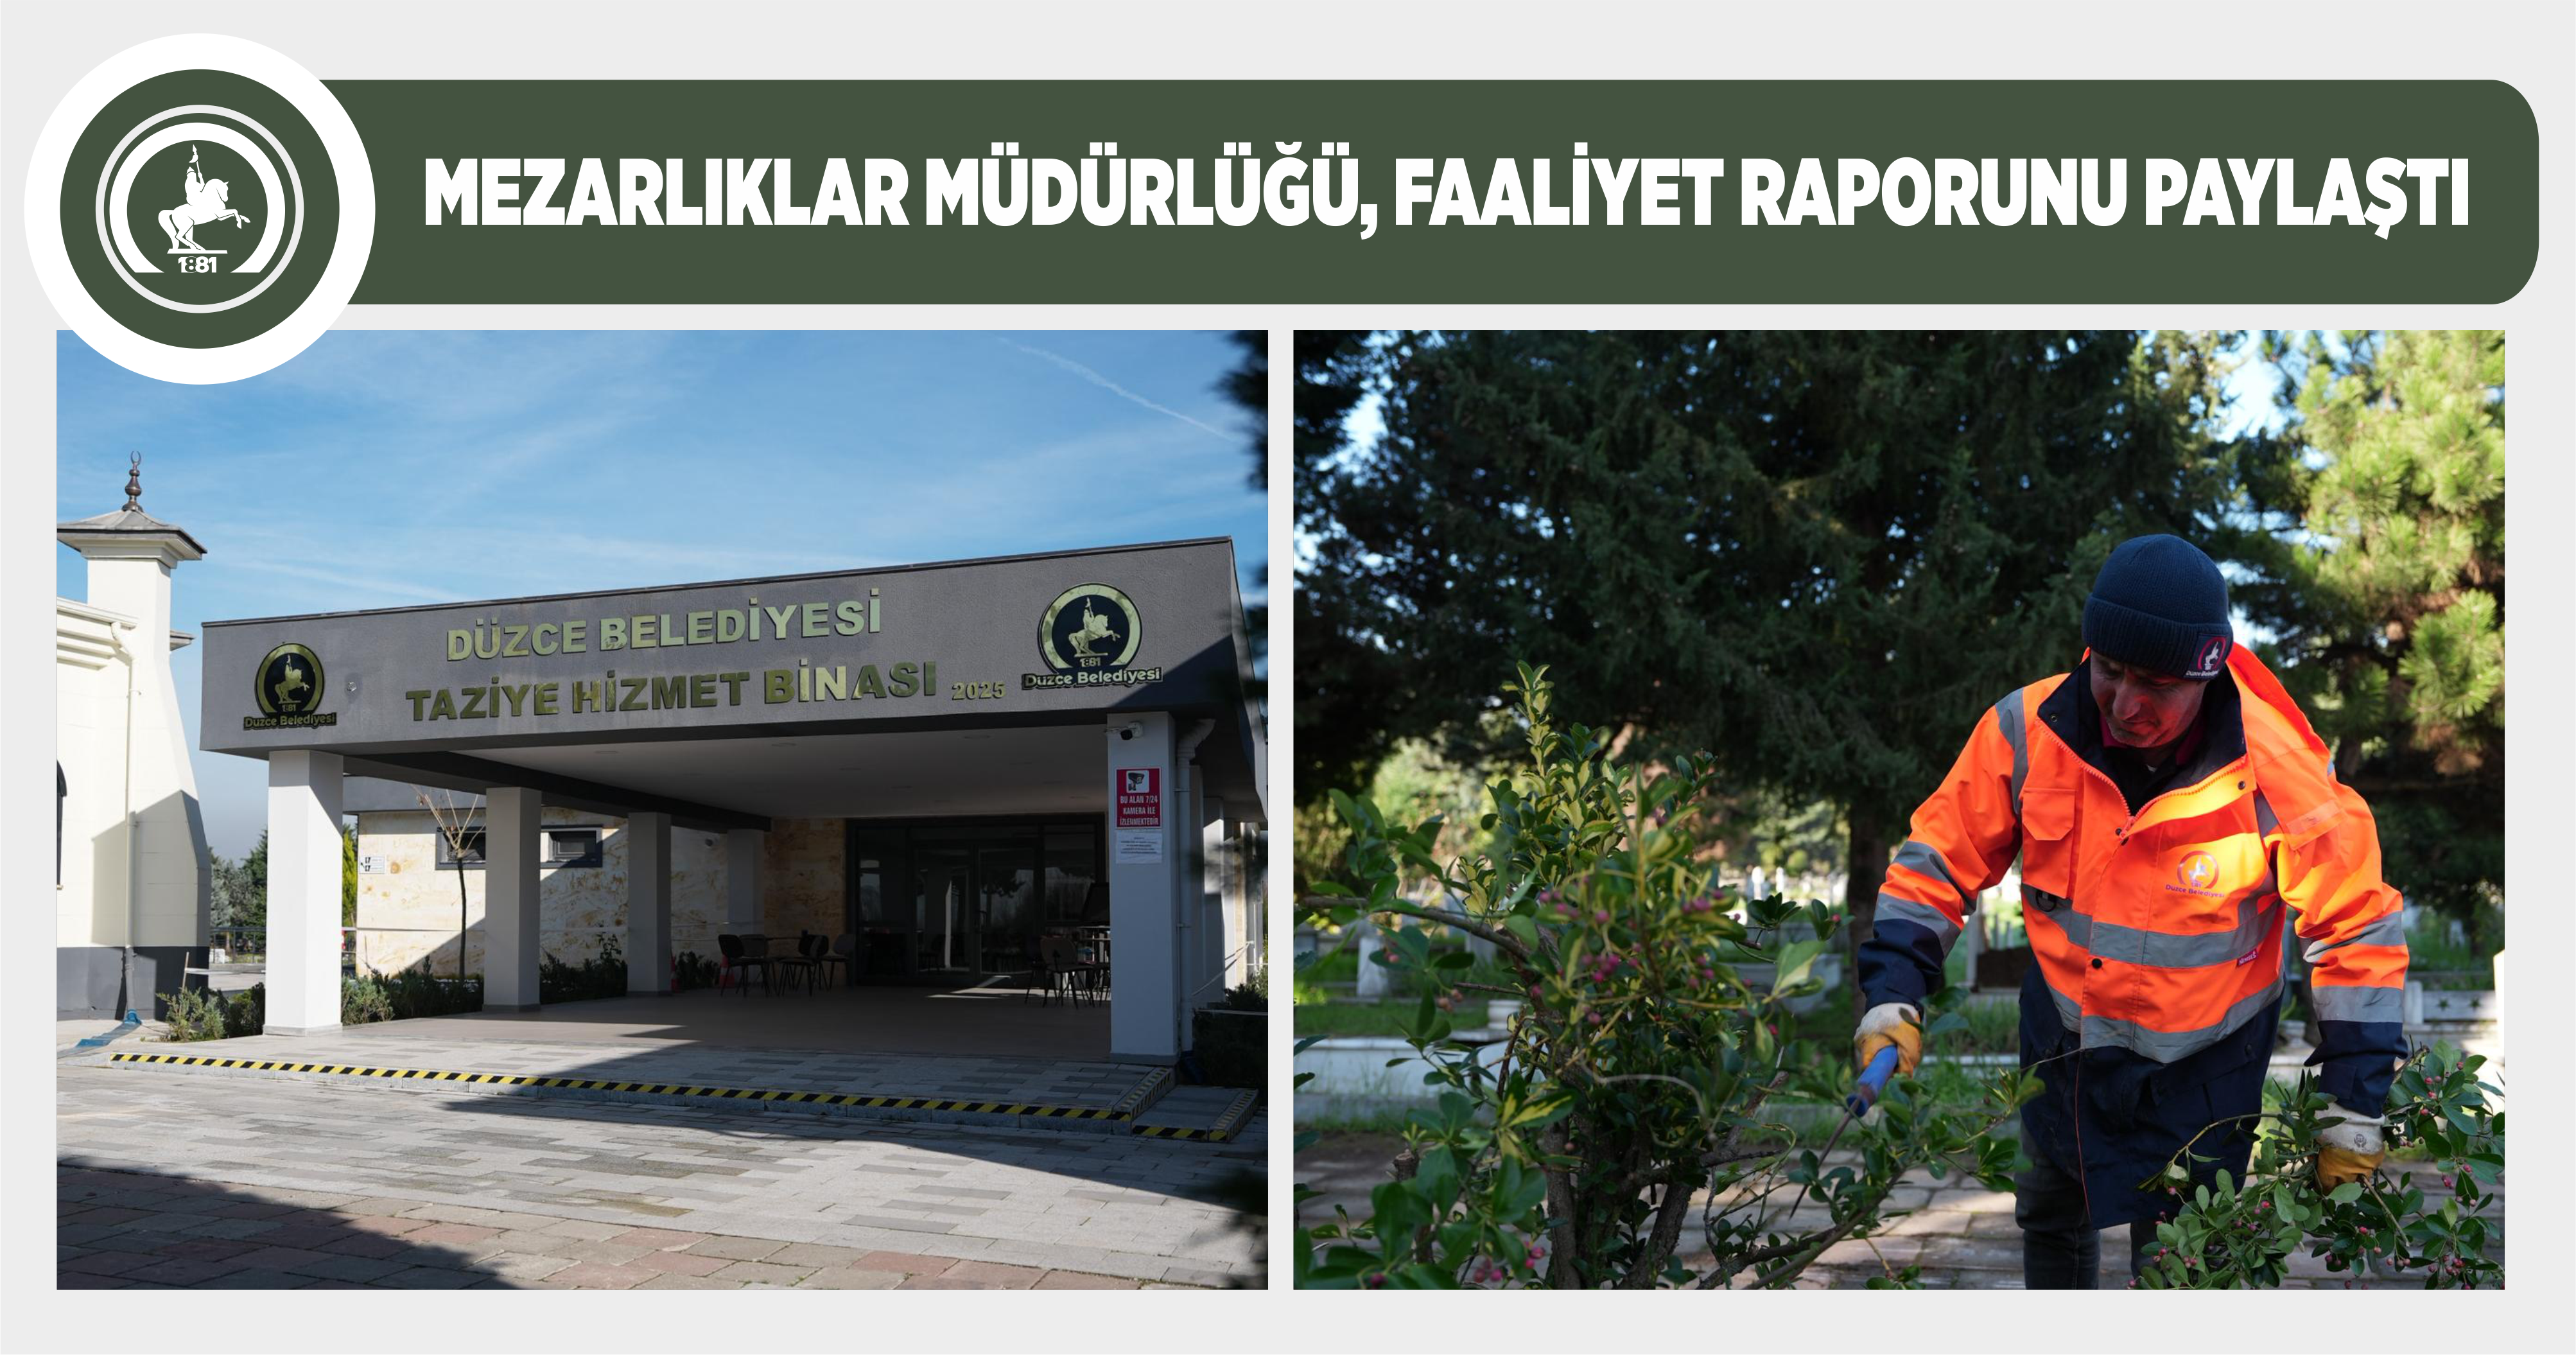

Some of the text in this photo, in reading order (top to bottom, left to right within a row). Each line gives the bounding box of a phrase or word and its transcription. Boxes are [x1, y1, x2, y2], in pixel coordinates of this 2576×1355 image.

[448, 588, 880, 661] DÜZCE BELEDİYESİ
[1077, 667, 1160, 684] Belediyesi
[406, 658, 1007, 721] TAZİYE HİZMET BİNASI 2025
[1145, 795, 1158, 804] 7/24
[1147, 805, 1156, 814] İLE
[1120, 816, 1159, 826] İZLENMEKTEDİR
